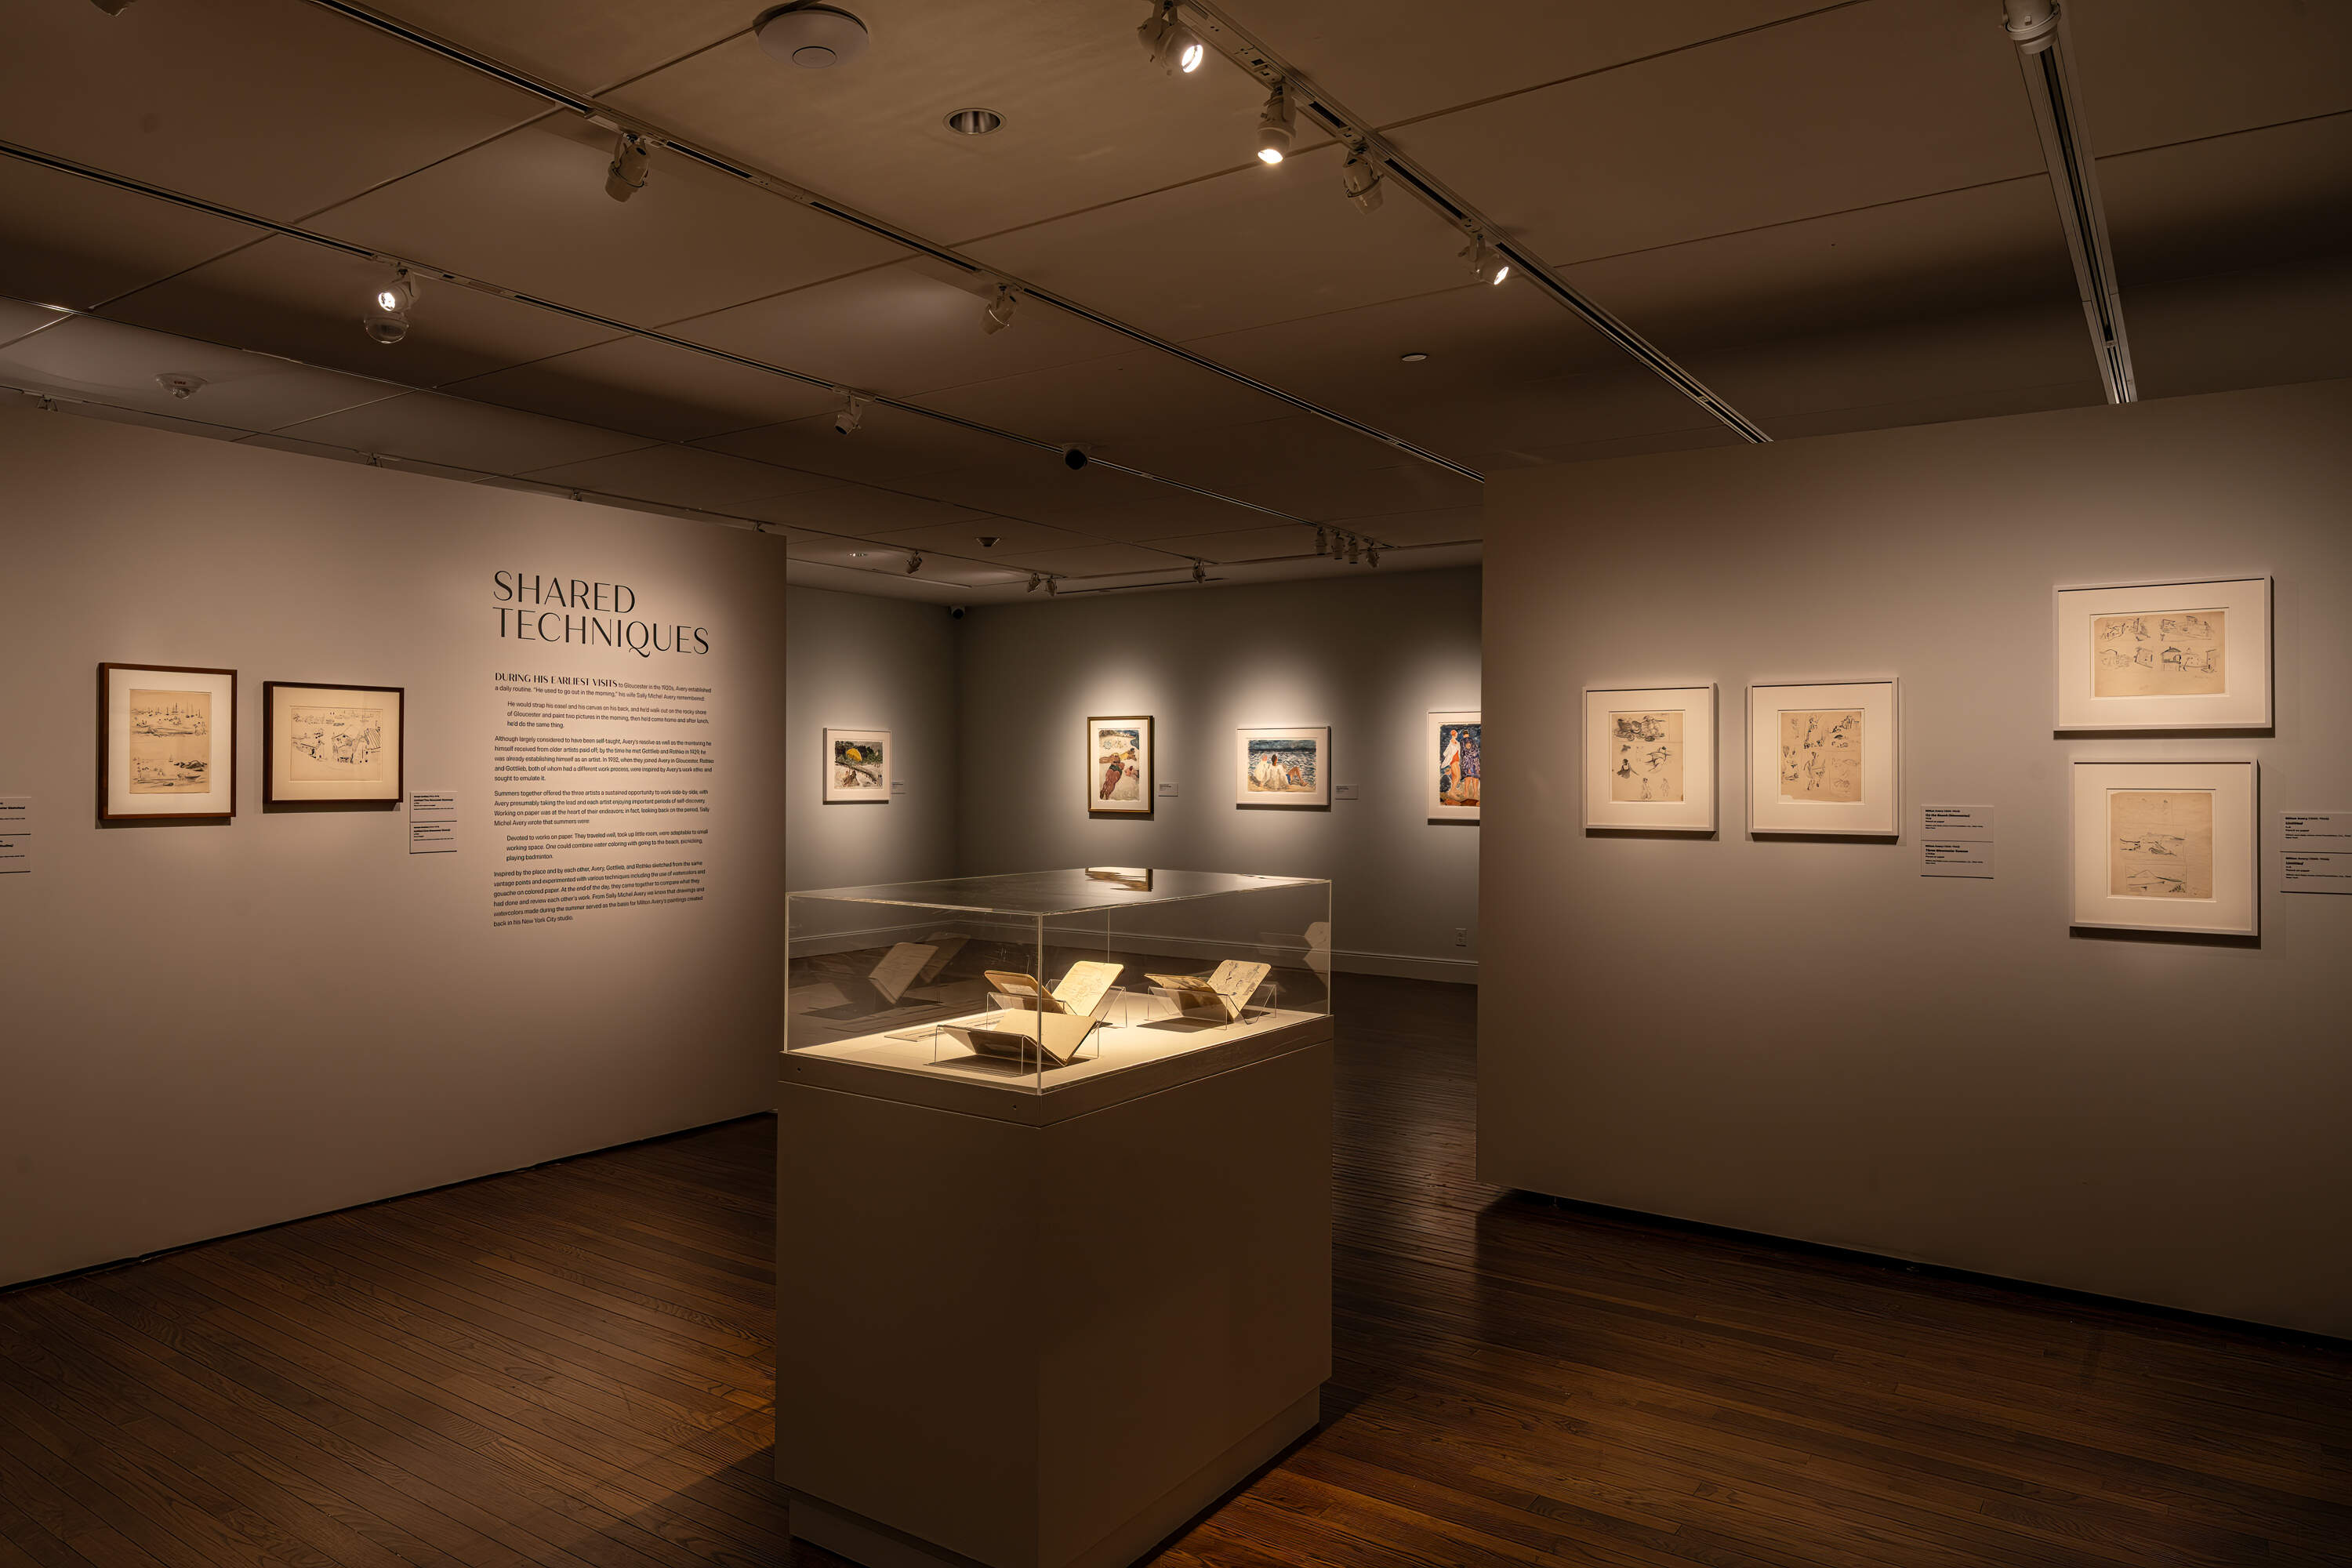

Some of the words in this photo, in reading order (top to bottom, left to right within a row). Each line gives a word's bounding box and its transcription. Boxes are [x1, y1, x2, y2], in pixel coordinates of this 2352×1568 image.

[493, 570, 635, 613] SHARED
[492, 607, 709, 658] TECHNIQUES
[495, 672, 531, 683] DURING
[534, 675, 548, 684] HIS
[551, 677, 589, 686] EARLIEST
[592, 678, 618, 688] VISITS
